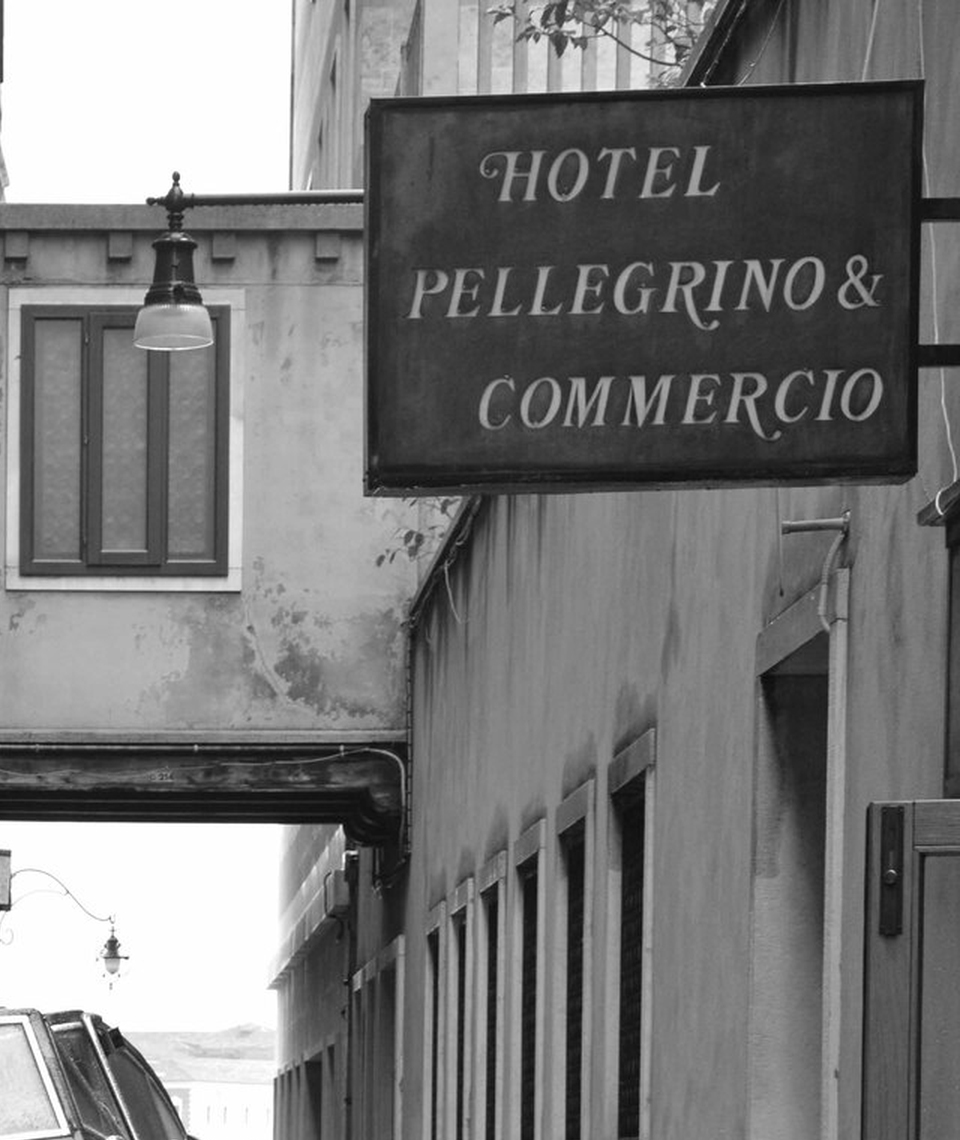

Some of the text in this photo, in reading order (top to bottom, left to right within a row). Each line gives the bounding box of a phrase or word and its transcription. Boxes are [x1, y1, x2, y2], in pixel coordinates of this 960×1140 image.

[480, 146, 719, 201] HOTEL
[409, 256, 881, 330] PELLEGRINO &
[479, 369, 882, 438] COMMERCIO
